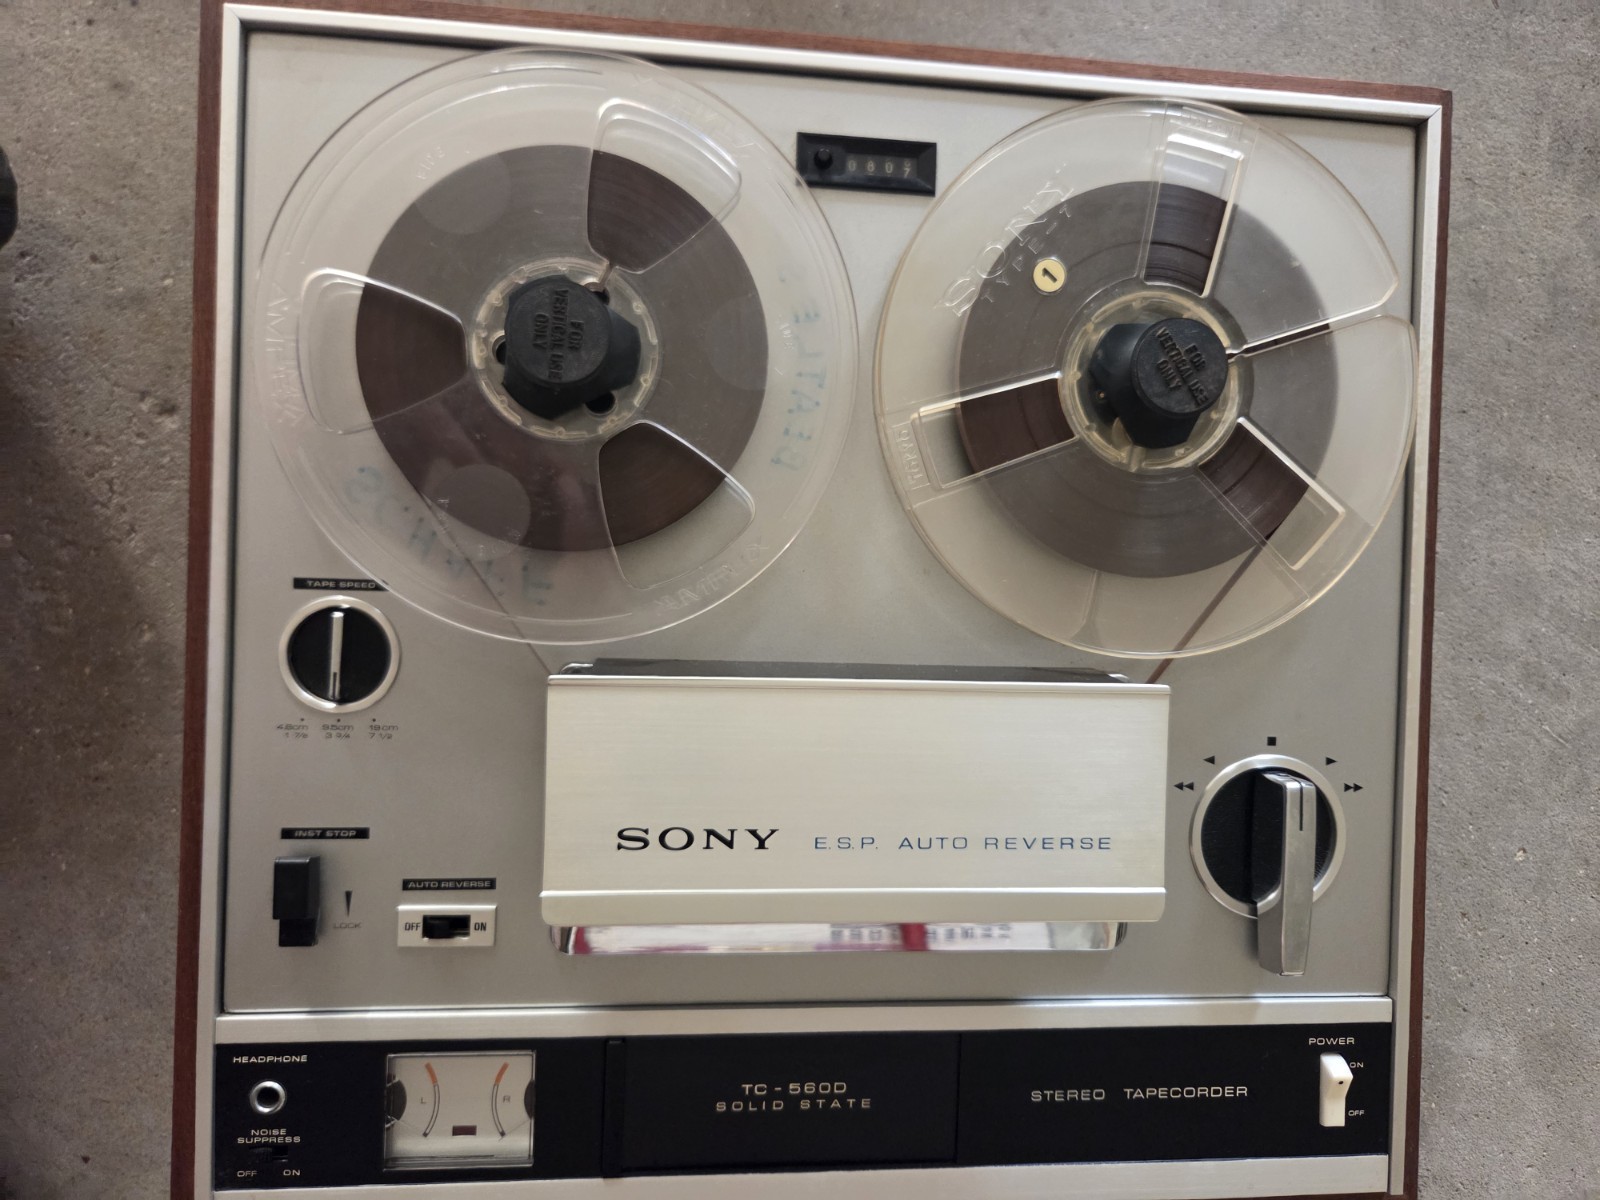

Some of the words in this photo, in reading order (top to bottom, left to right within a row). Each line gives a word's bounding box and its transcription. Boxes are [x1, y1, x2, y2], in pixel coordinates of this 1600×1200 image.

[934, 182, 1075, 317] SONY
[1041, 266, 1058, 284] 1
[549, 288, 570, 351] VERTICAL
[532, 312, 550, 351] ONLY
[567, 319, 585, 352] FOR
[1183, 342, 1207, 372] FOR
[547, 352, 565, 381] USE
[1155, 326, 1196, 385] VERTICAL
[1187, 378, 1210, 407] USE
[1156, 358, 1183, 390] ONLY
[306, 580, 337, 589] TAPE
[338, 581, 376, 590] SPEED
[294, 829, 322, 837] INST
[325, 829, 357, 837] STOP
[616, 827, 779, 851] SONY
[814, 836, 879, 850] E.S.P.
[899, 836, 969, 850] AUTO
[984, 836, 1112, 850] REVERSE
[407, 879, 439, 888] AUTO
[441, 879, 492, 888] REVERSE
[332, 921, 362, 929] LOCK
[404, 921, 421, 932] OFF
[474, 921, 487, 932] ON
[1308, 1037, 1355, 1046] POWER
[233, 1054, 308, 1064] HEADPHONE
[1349, 1061, 1364, 1069] ON
[1030, 1088, 1106, 1102] STEREO
[1123, 1086, 1248, 1100] TAPECORDER
[715, 1100, 785, 1112] SOLID
[799, 1098, 872, 1110] STATE
[1348, 1109, 1365, 1117] OFF
[250, 1128, 287, 1136] NOISE
[237, 1135, 301, 1144] SUPPRESS
[236, 1169, 258, 1178] OFF
[283, 1168, 301, 1177] ON
